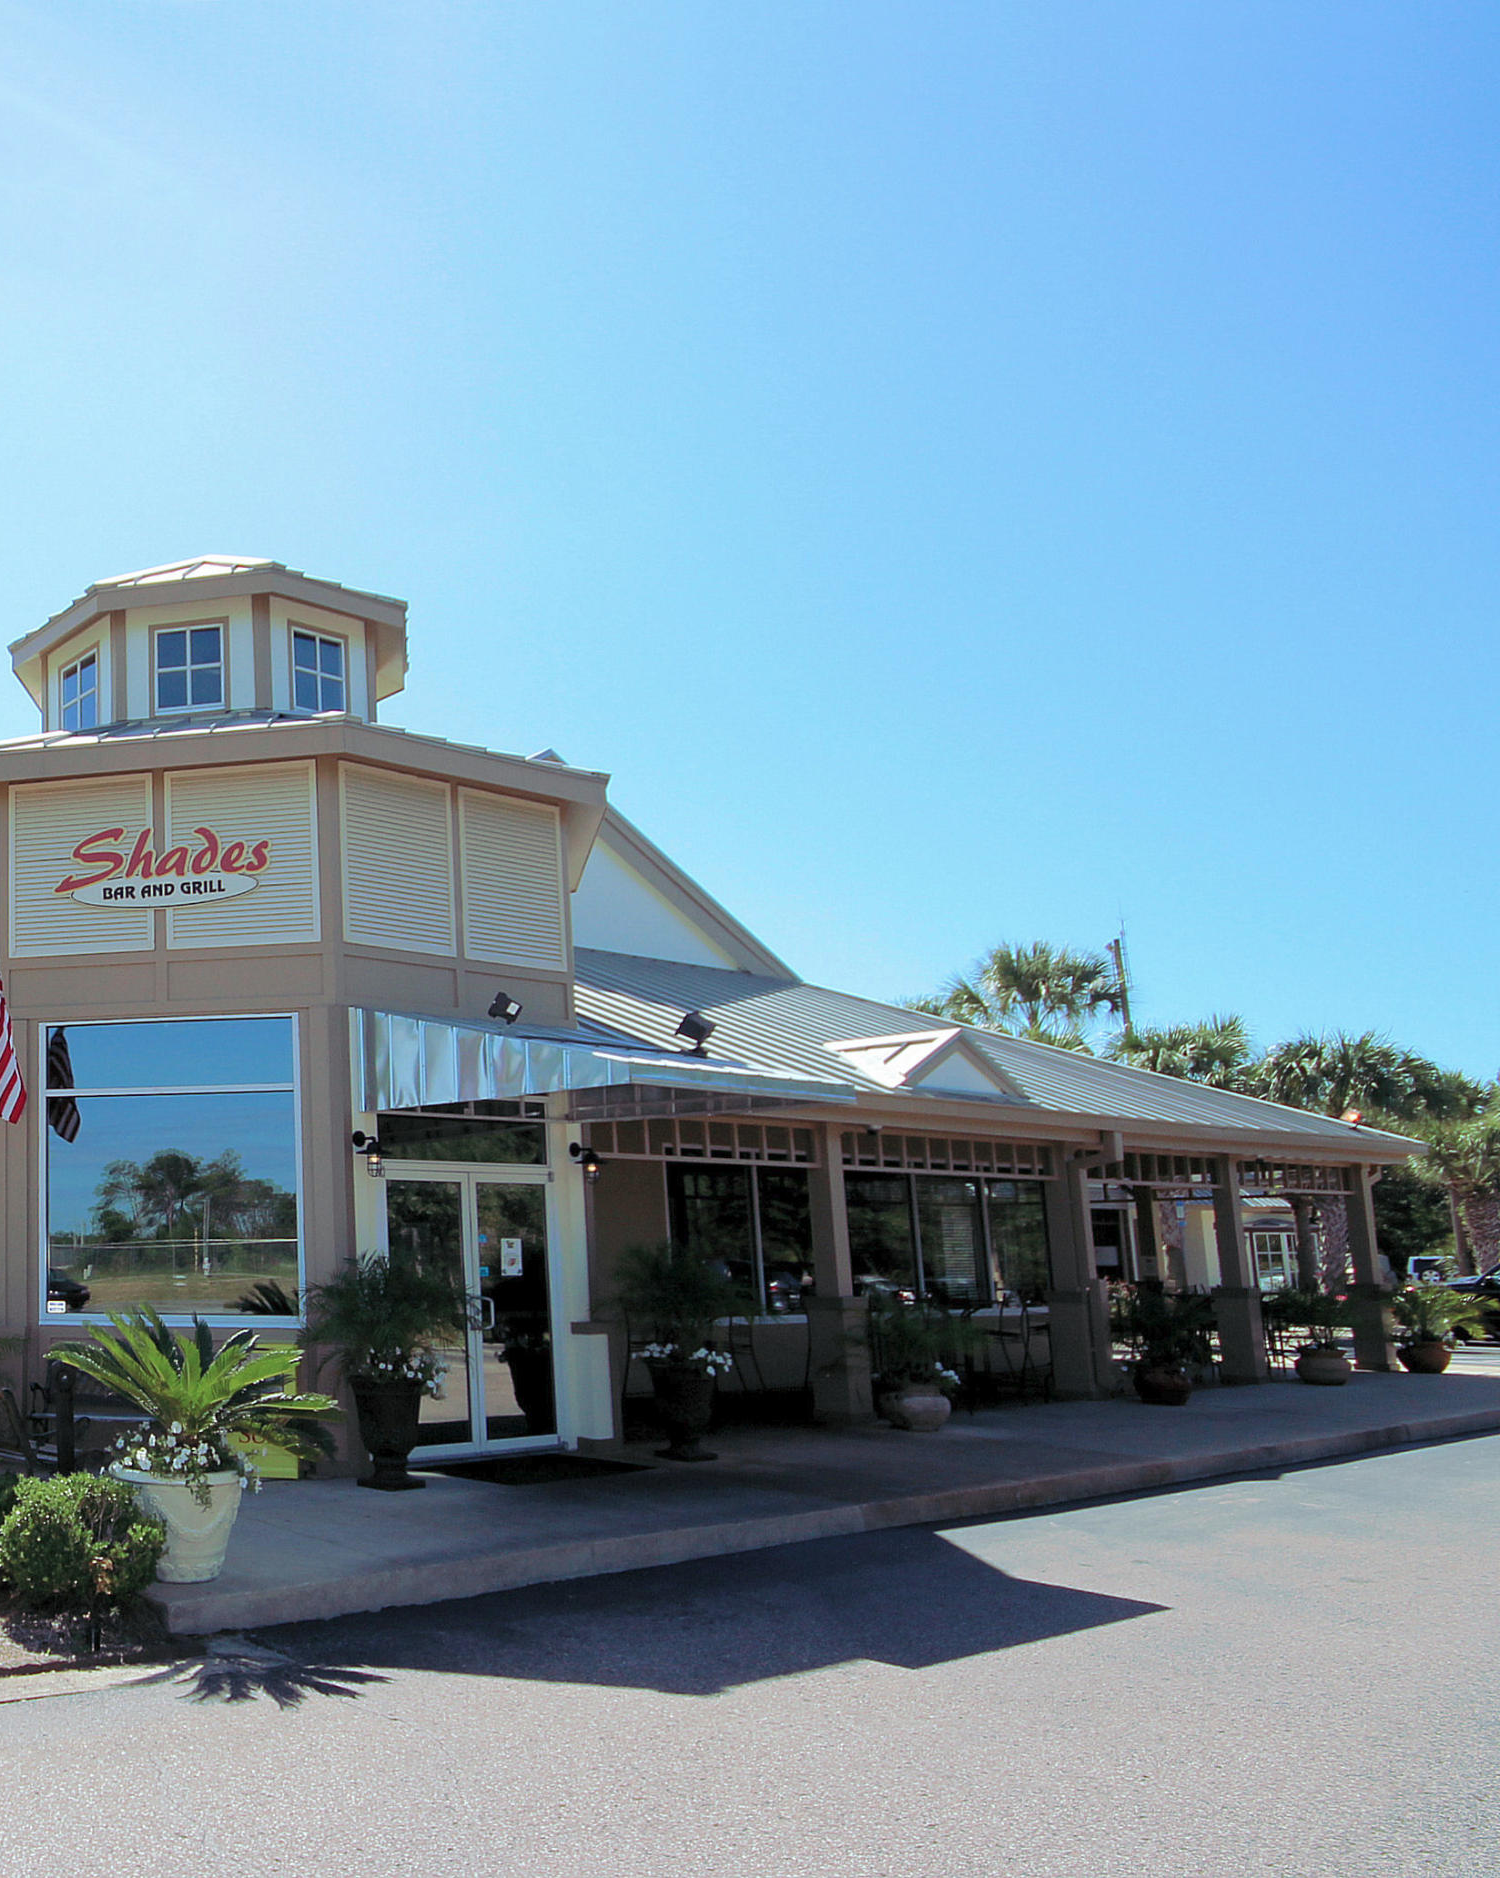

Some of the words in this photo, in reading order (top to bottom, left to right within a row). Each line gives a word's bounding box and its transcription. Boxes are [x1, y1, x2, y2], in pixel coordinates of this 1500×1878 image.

[54, 827, 270, 893] Shades
[102, 886, 136, 900] BAR
[140, 883, 175, 899] AND
[180, 879, 226, 895] GRILL
